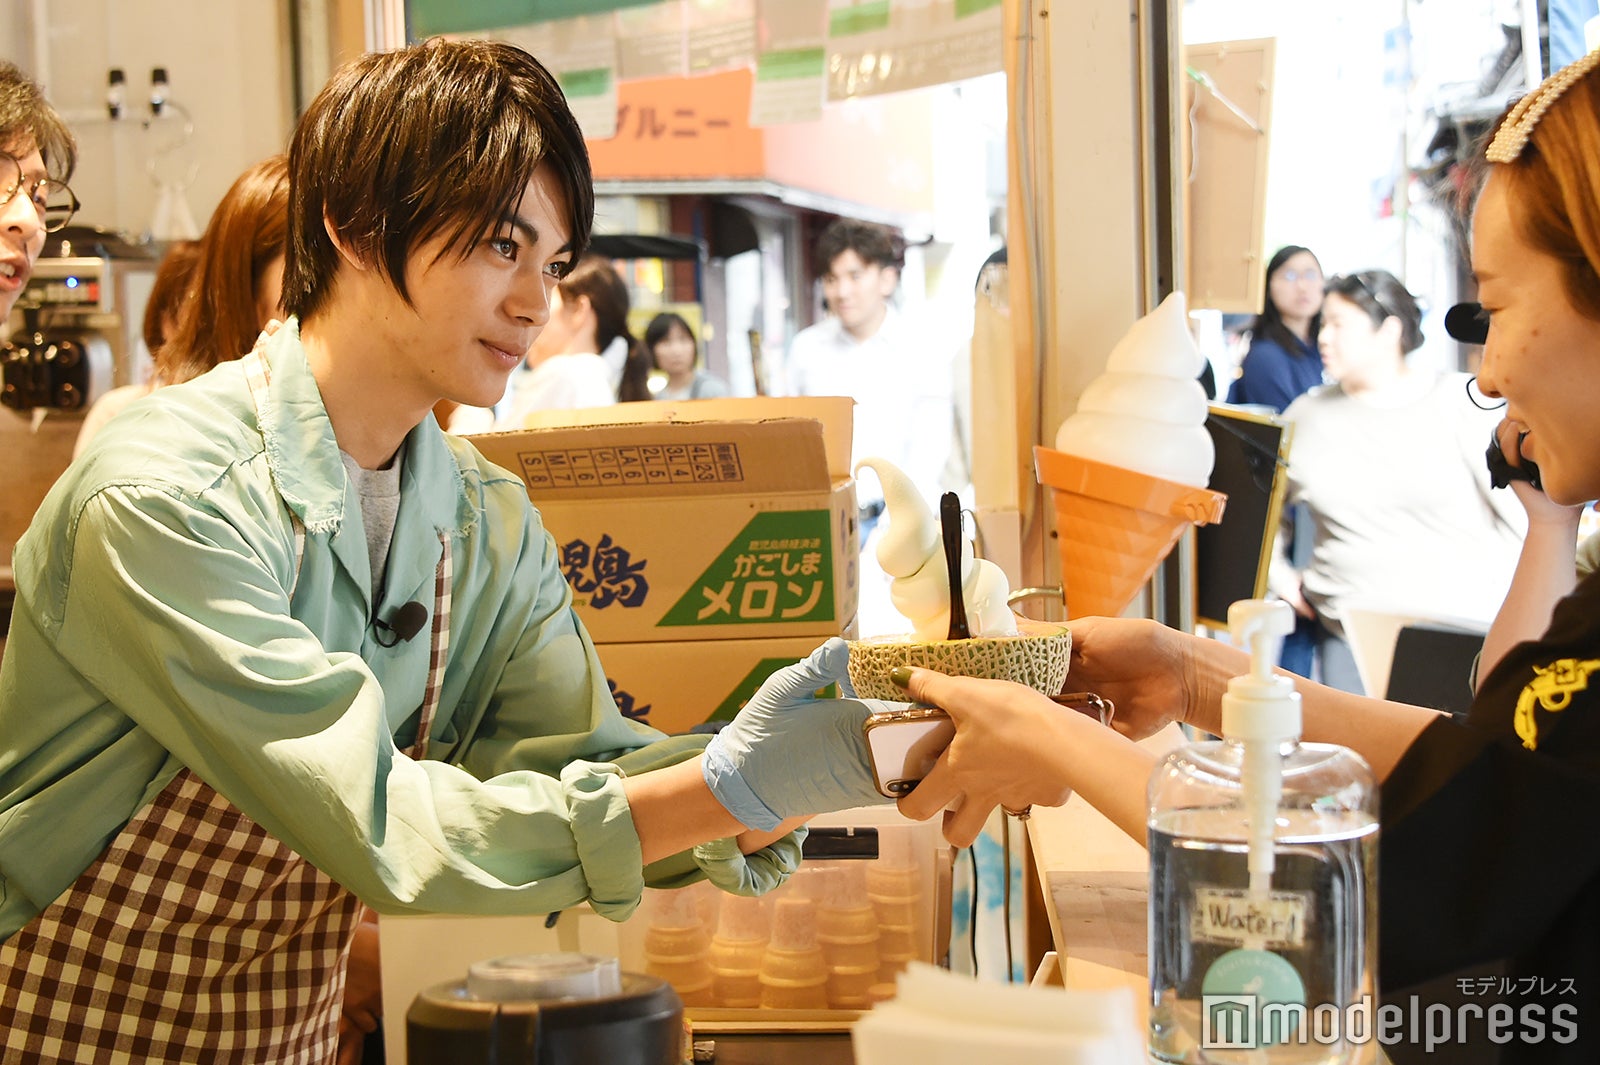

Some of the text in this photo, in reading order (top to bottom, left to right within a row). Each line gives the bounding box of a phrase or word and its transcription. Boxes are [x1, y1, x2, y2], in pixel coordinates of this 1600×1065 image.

[547, 455, 566, 465] M
[572, 455, 588, 463] L
[618, 448, 638, 465] LA
[642, 448, 661, 463] 2L
[666, 447, 685, 462] 3L
[692, 446, 710, 461] 4L
[525, 457, 548, 483] S 8
[732, 552, 822, 578] かごしま
[697, 580, 823, 620] メロン
